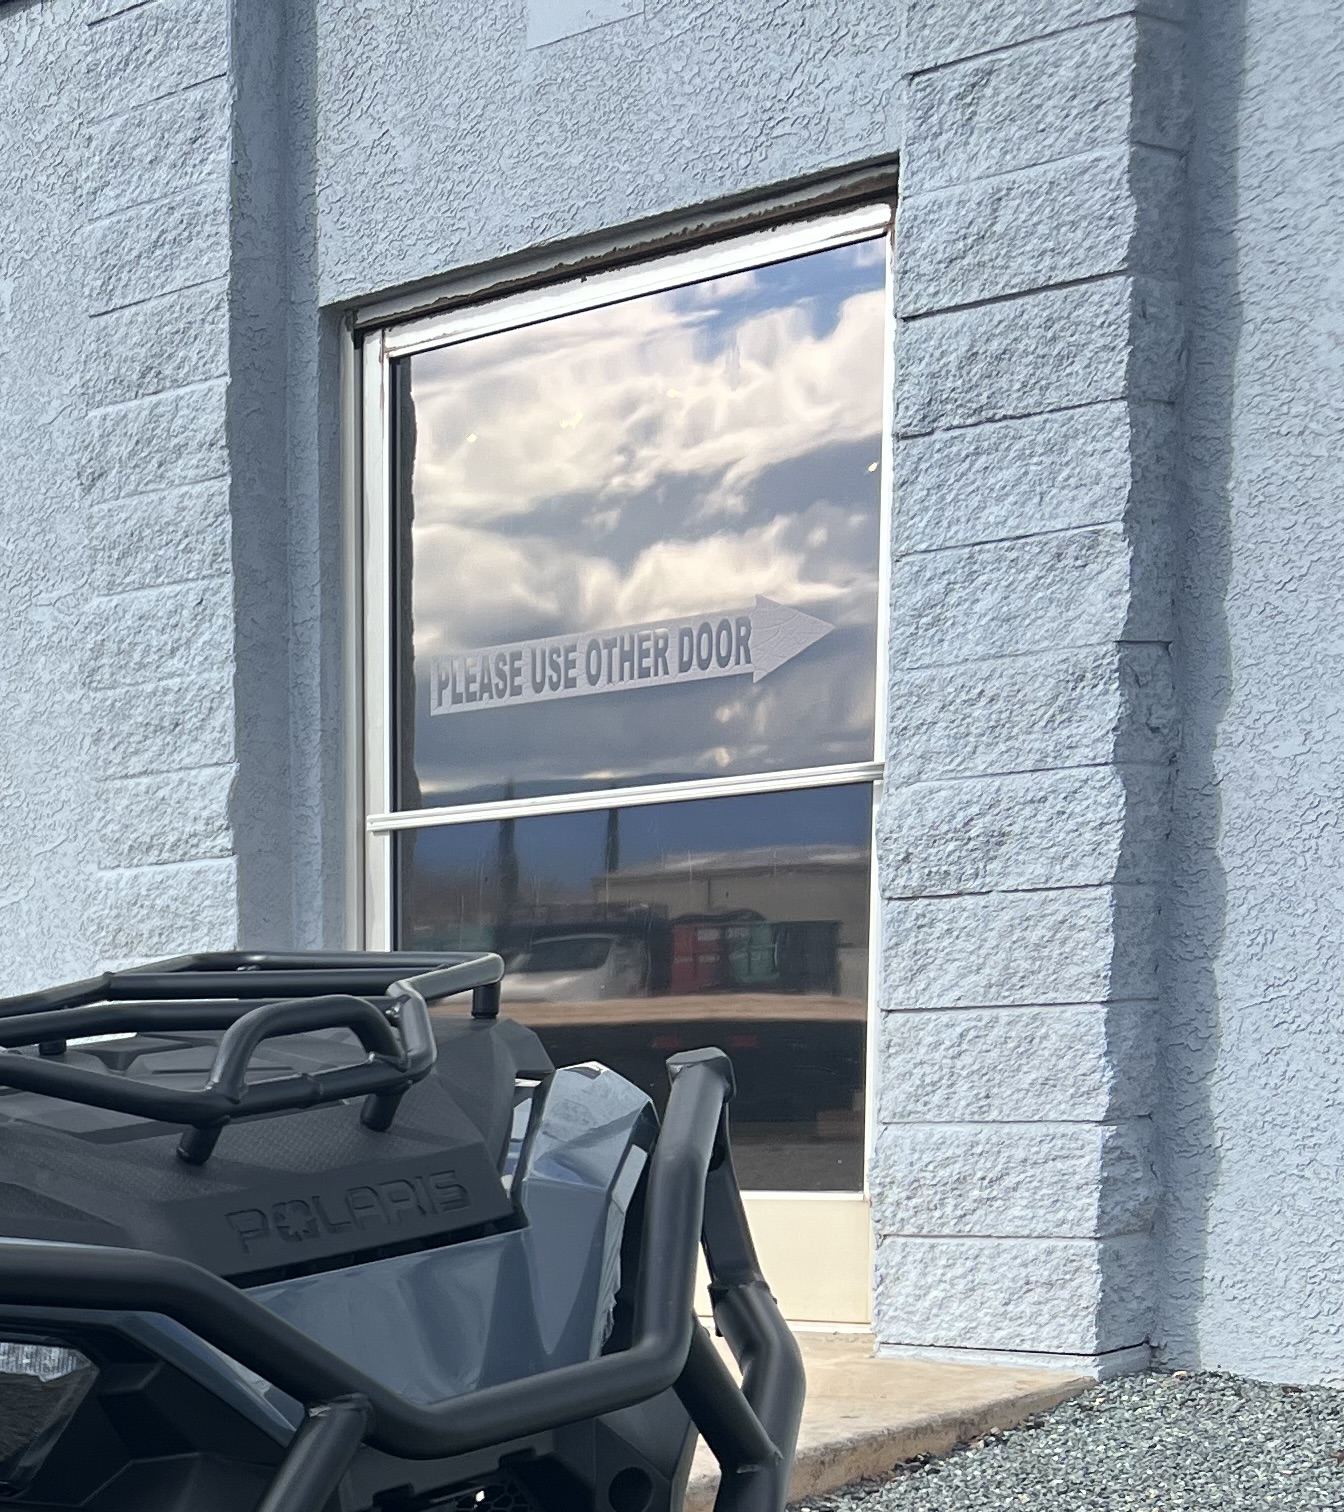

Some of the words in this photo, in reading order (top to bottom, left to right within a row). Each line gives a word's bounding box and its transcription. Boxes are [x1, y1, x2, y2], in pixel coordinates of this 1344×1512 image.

[435, 651, 523, 708] PLEASE
[529, 644, 577, 693] USE
[584, 627, 670, 687] OTHER
[678, 616, 753, 674] DOOR
[224, 1170, 472, 1254] POLARIS
